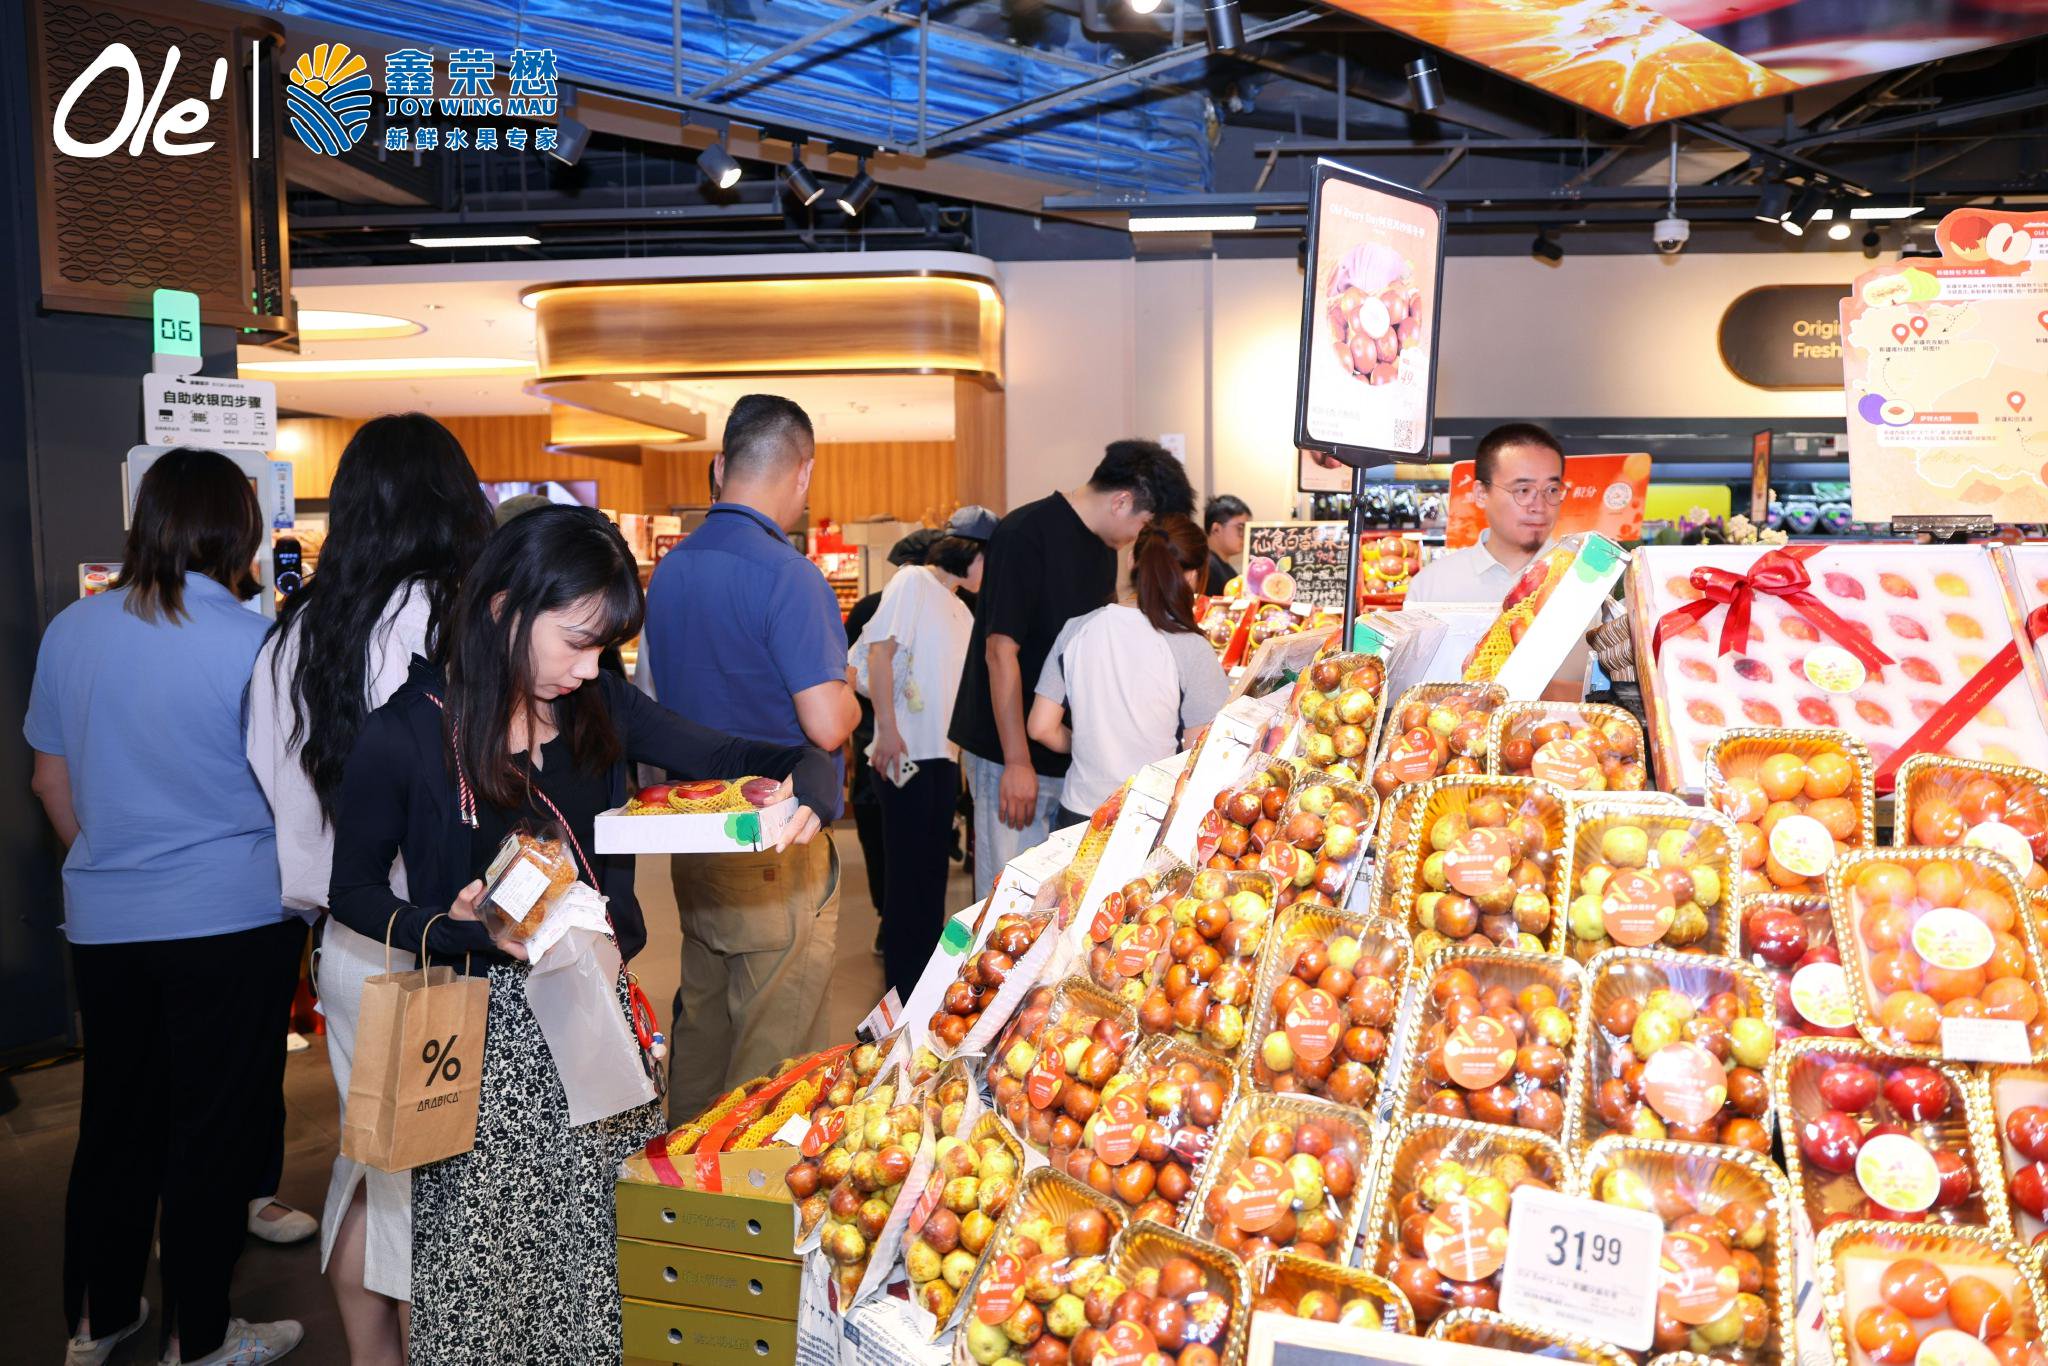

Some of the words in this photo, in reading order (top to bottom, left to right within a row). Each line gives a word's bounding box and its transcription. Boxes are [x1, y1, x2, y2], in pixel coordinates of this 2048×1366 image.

[161, 318, 193, 342] 06
[1792, 319, 1841, 340] Origi
[1793, 341, 1843, 359] Fresh
[163, 390, 262, 409] 自助收银四步骤
[416, 1092, 460, 1112] ARABICA
